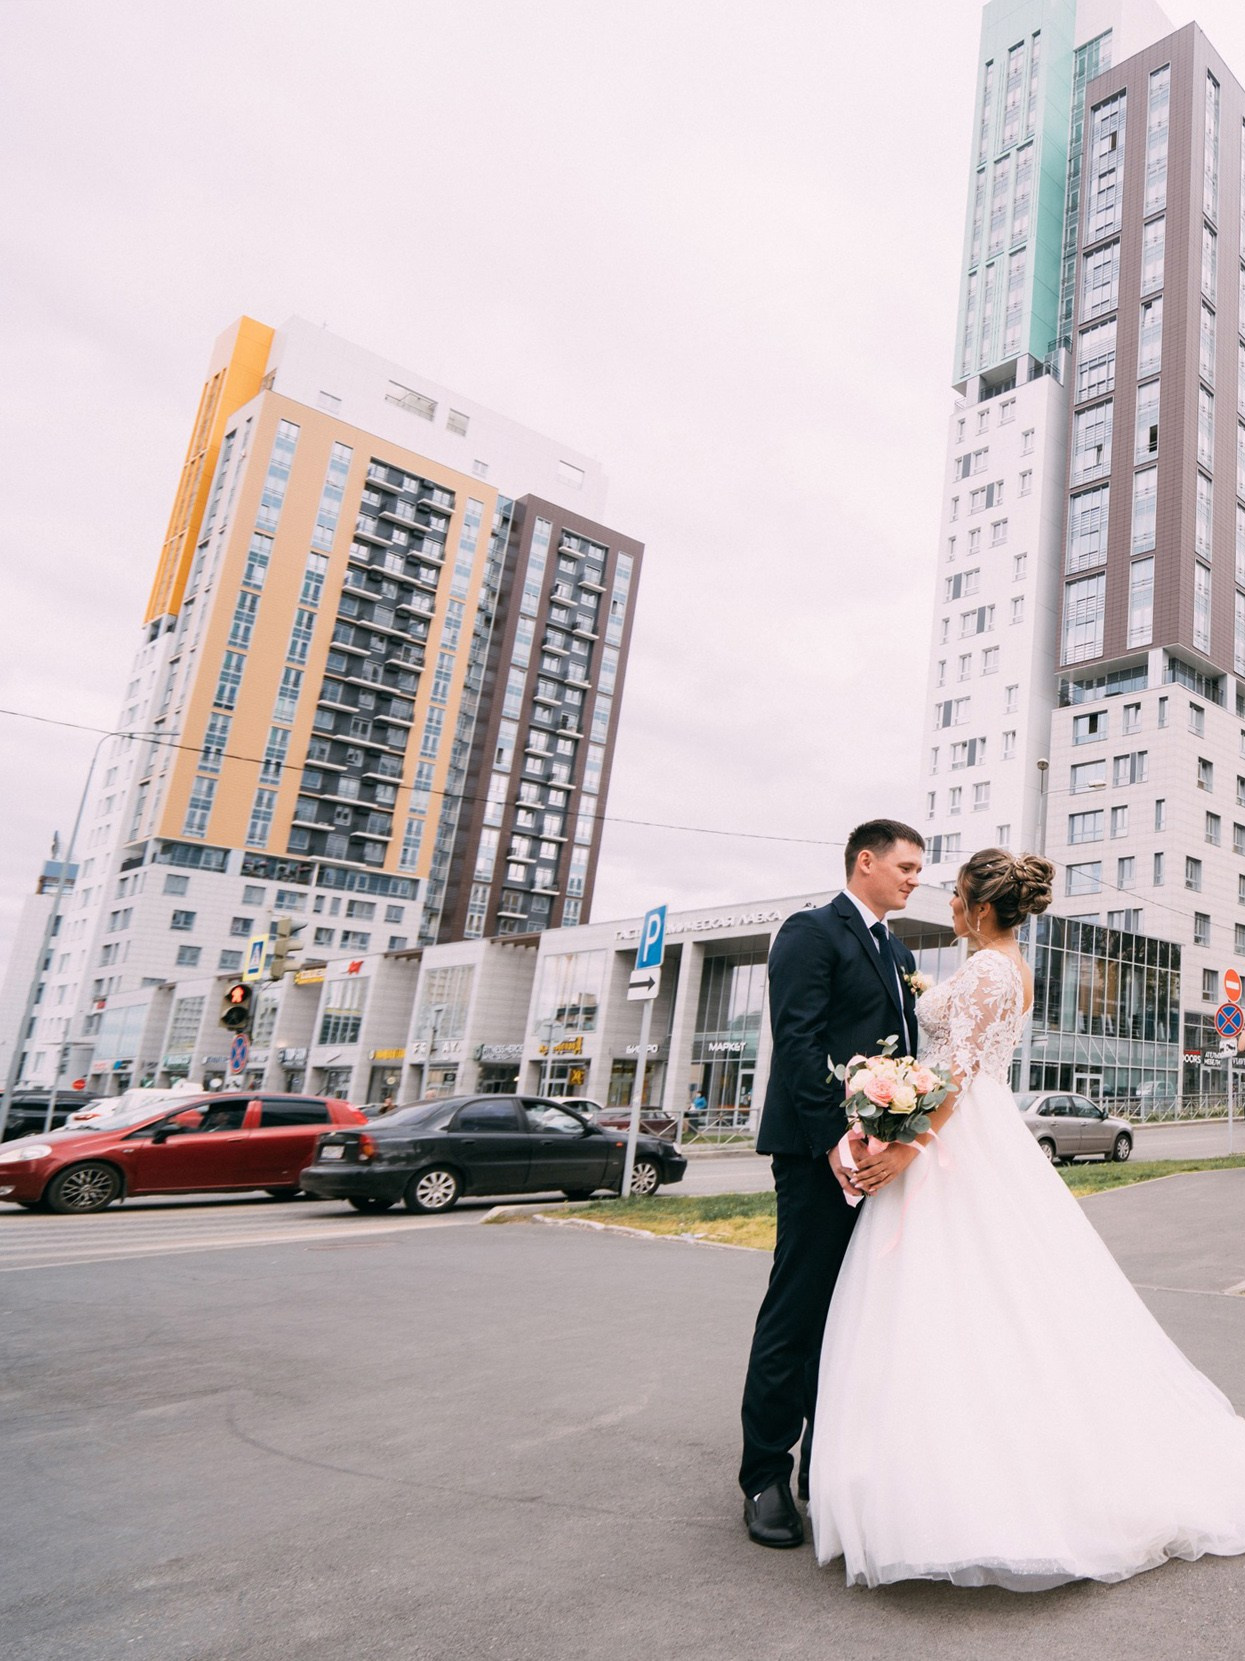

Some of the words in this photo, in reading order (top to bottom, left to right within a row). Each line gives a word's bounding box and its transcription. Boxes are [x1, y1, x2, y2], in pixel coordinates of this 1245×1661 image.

[738, 910, 783, 927] ЛАВКА
[642, 913, 662, 962] P
[708, 1041, 748, 1052] МАРКЕТ
